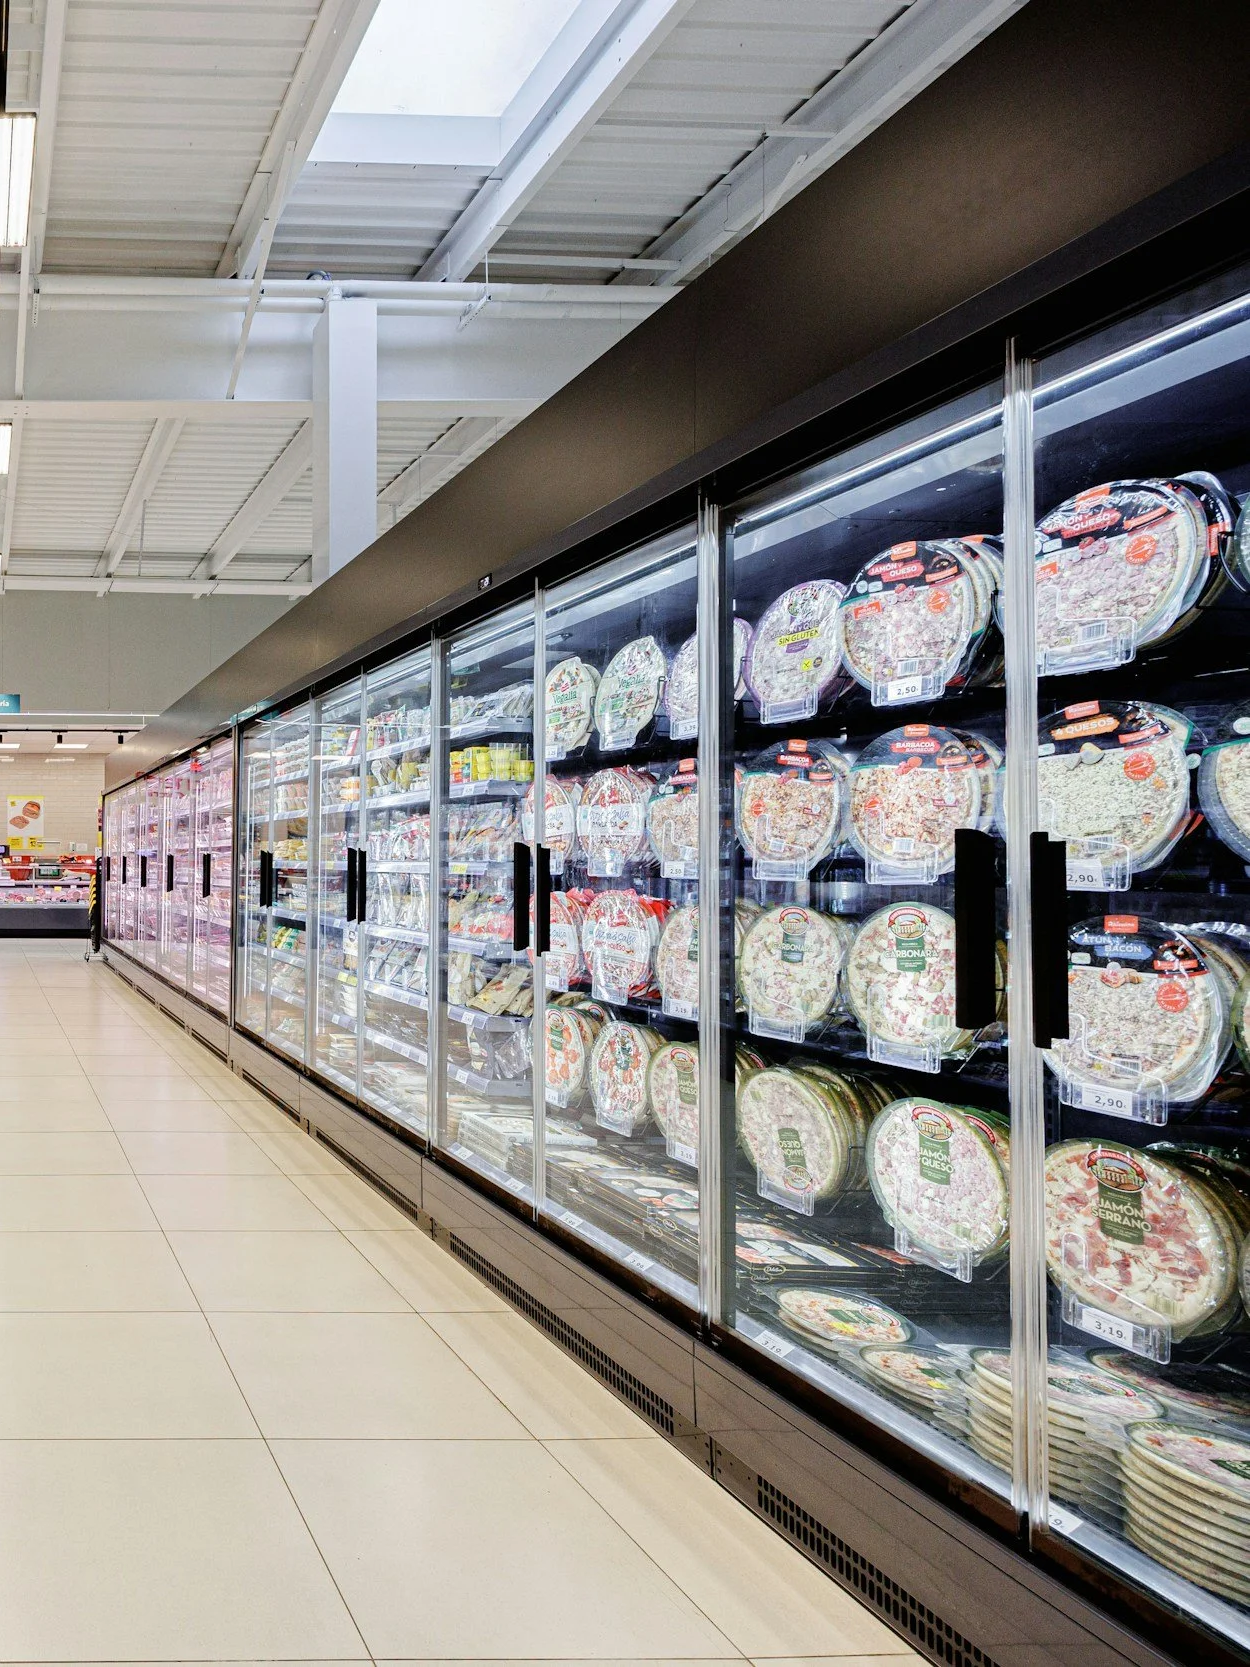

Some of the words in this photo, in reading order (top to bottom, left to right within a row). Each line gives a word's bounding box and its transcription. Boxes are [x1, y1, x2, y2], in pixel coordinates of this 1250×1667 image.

[889, 565, 918, 577] QUESO
[778, 636, 790, 646] SIN
[1065, 717, 1114, 734] QUESOS
[884, 949, 939, 958] CARBONARA
[919, 1146, 950, 1162] JAMÓN
[921, 1157, 954, 1174] QUESO
[1099, 1198, 1145, 1220] JAMÓN
[1092, 1208, 1152, 1233] SERRANO
